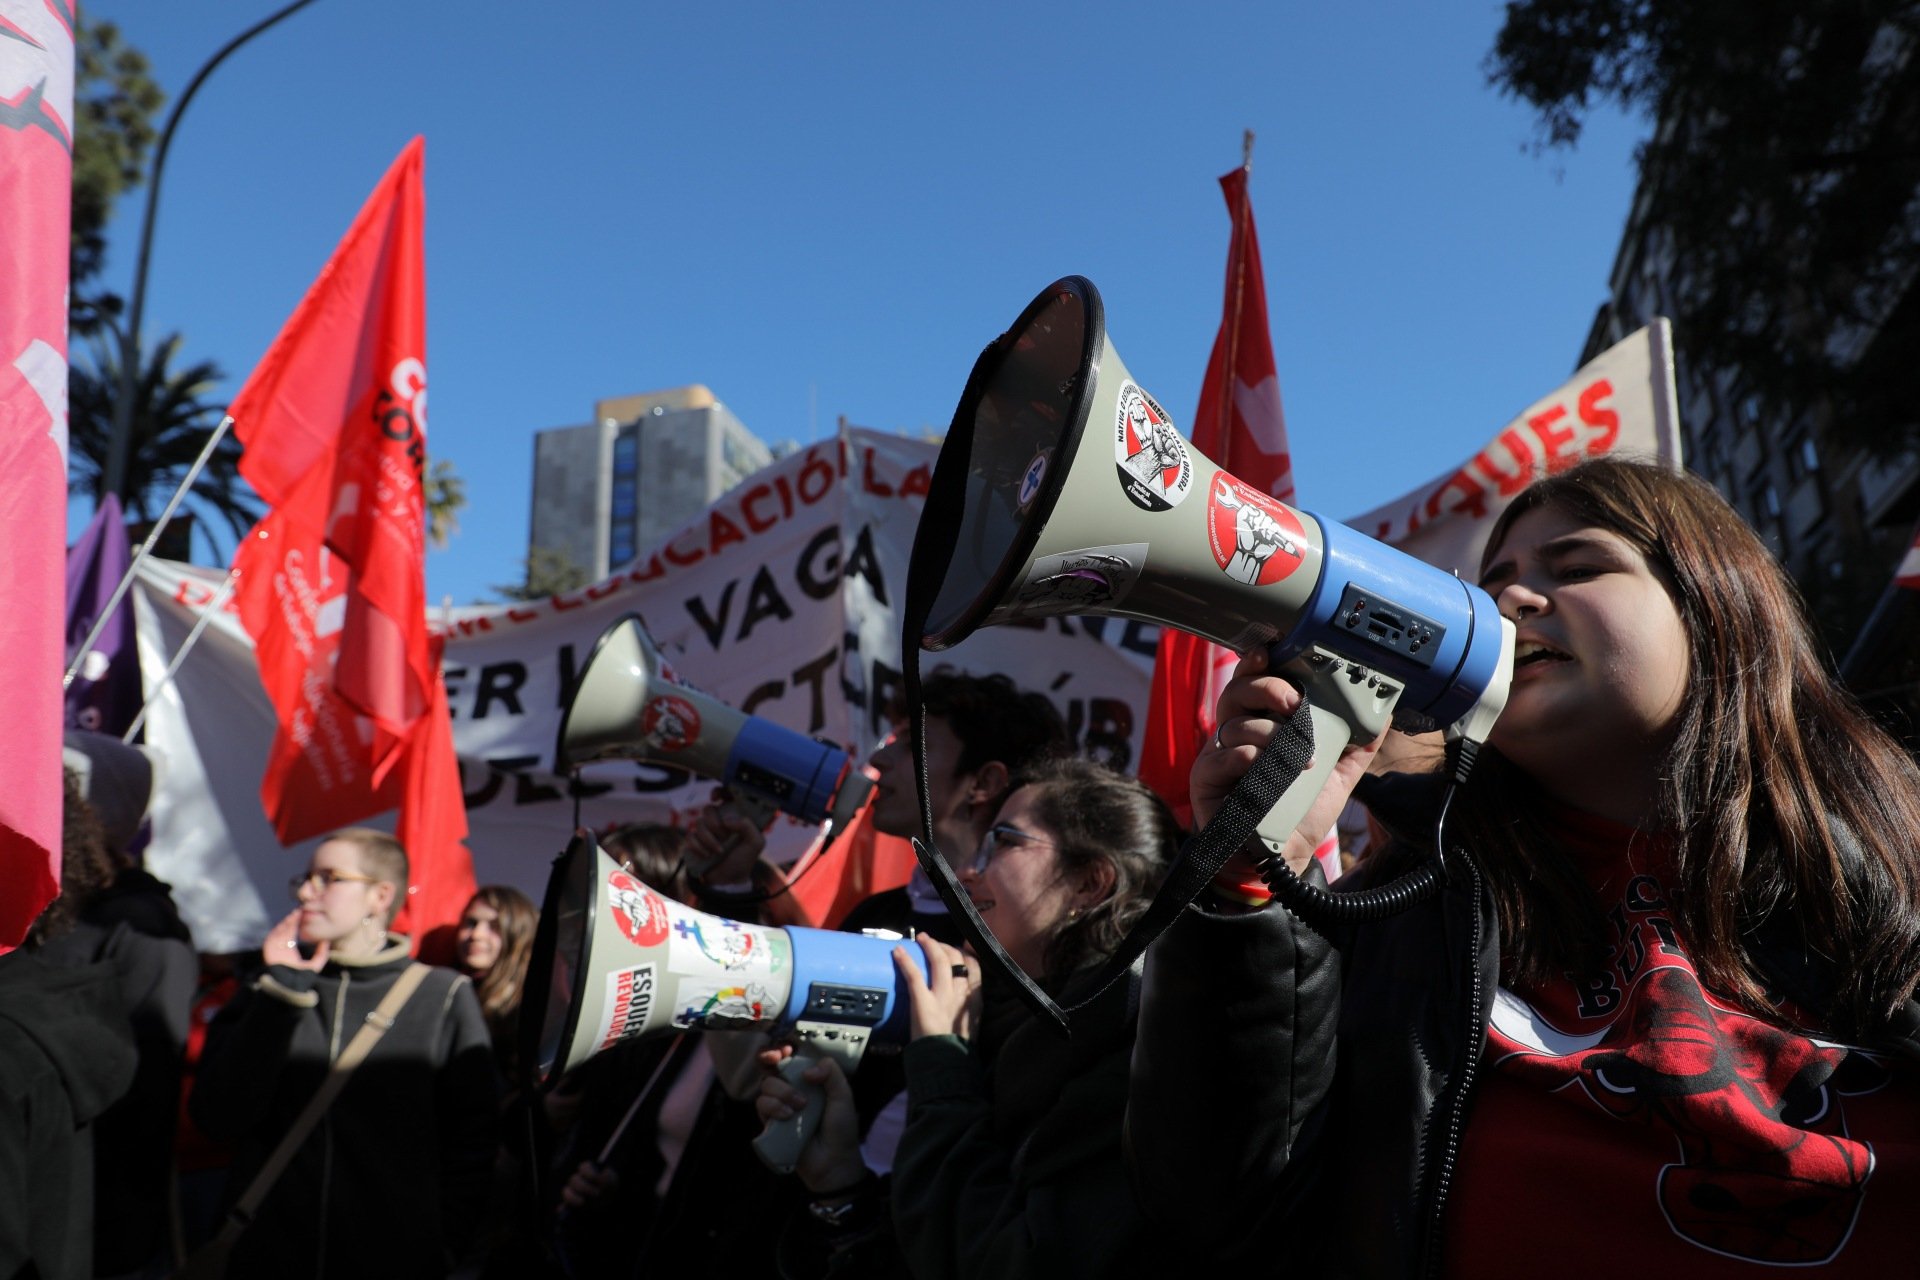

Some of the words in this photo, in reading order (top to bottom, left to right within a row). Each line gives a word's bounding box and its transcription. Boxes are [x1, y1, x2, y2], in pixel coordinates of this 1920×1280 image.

[1118, 410, 1126, 442] NATIVA
[1177, 462, 1190, 492] OBRERA
[685, 522, 890, 653] VAGA
[620, 966, 652, 1040] ESQUER
